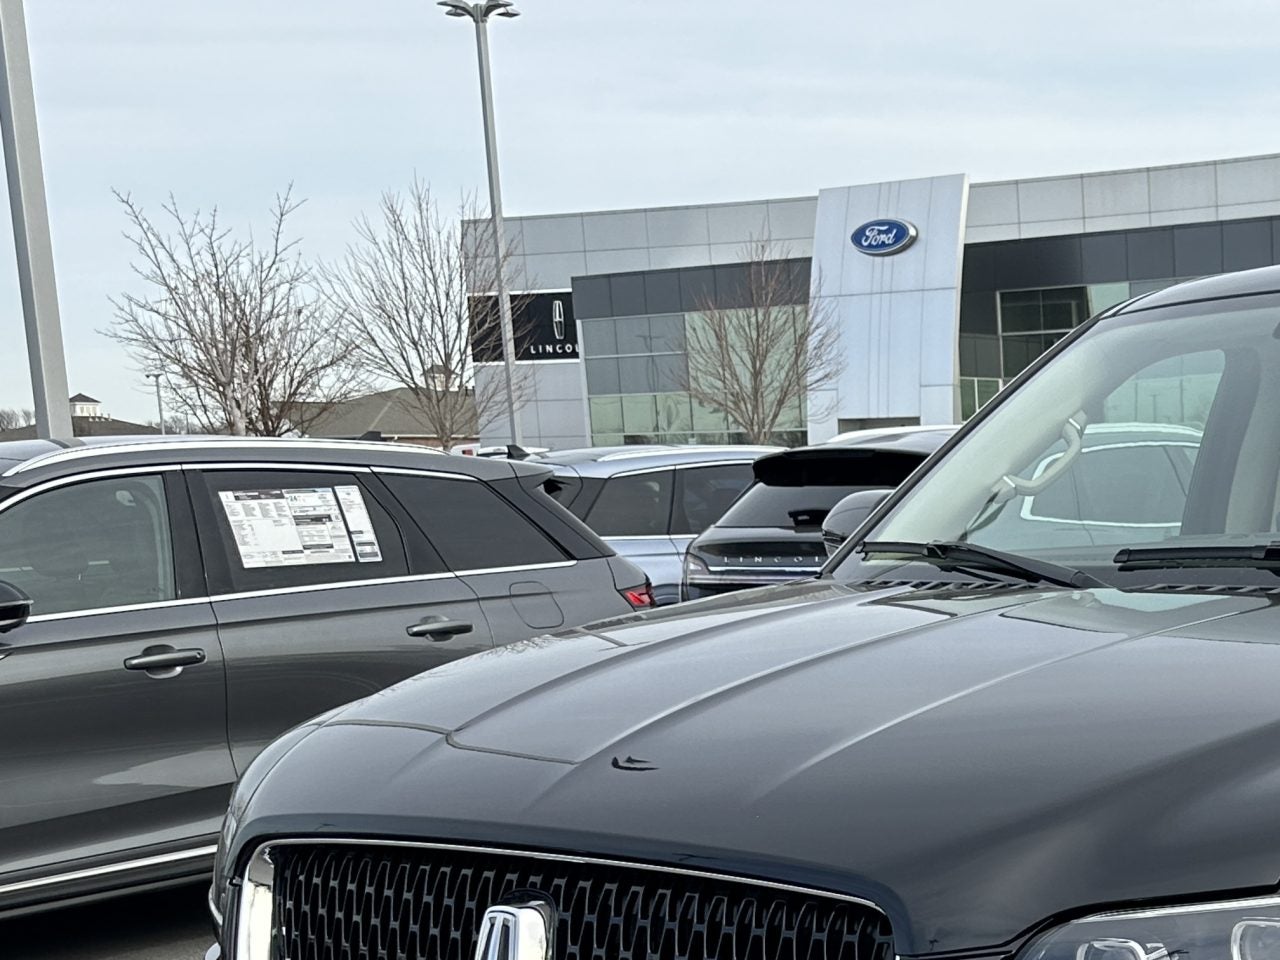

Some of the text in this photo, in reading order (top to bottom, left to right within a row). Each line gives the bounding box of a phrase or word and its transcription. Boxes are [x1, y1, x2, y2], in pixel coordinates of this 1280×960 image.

[861, 225, 898, 247] Ford
[530, 343, 580, 354] LINCOL
[723, 555, 821, 564] LINCOL
